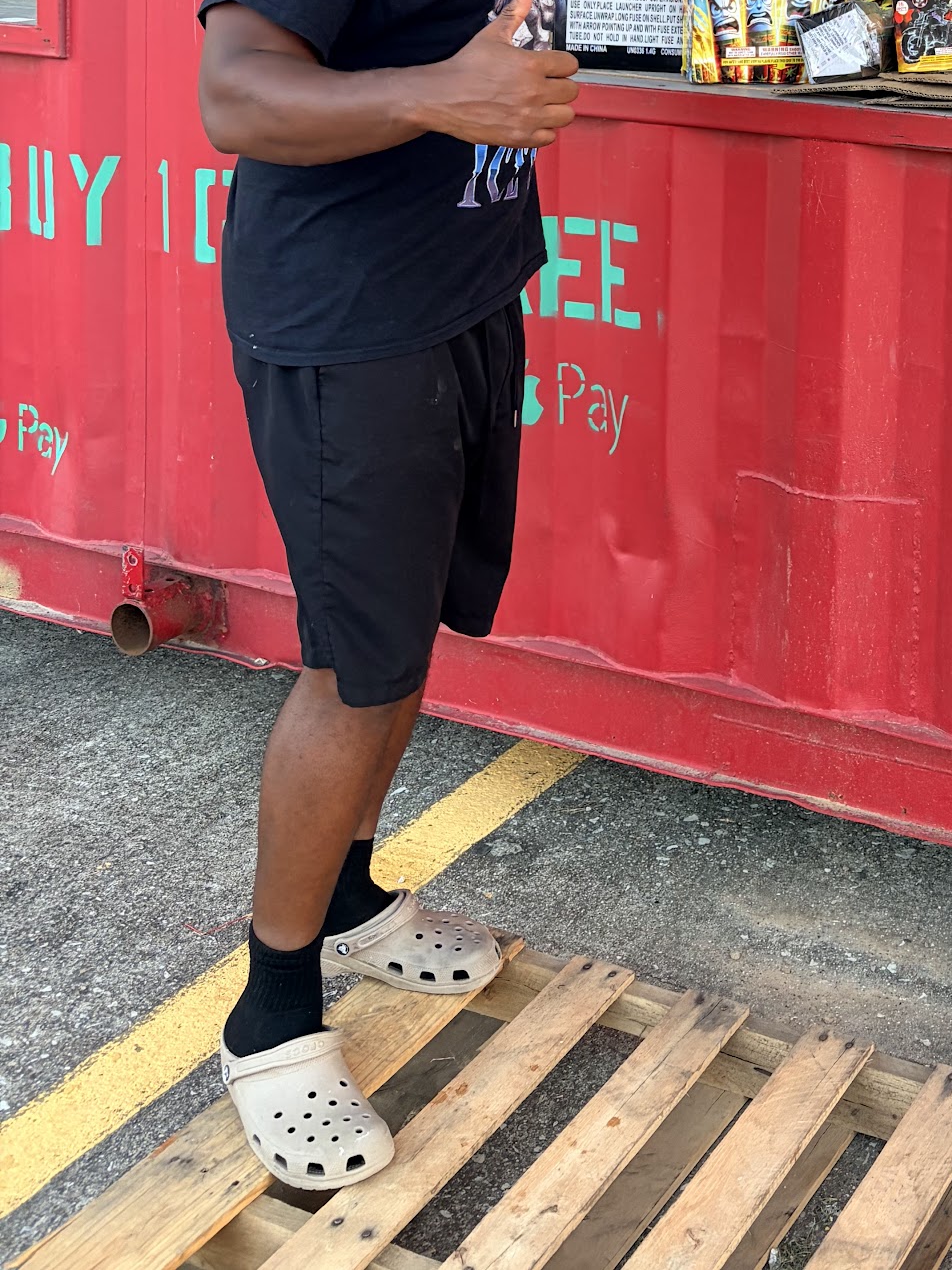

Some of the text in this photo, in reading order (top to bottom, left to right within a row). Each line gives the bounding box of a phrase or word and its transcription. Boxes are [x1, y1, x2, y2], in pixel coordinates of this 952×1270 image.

[571, 0, 580, 8] USE
[616, 3, 642, 11] LAUNCHER
[645, 4, 666, 13] UPRIGHT
[669, 5, 677, 13] ON
[615, 13, 628, 21] LONG
[629, 13, 641, 22] FUSE
[642, 14, 650, 22] ON
[570, 21, 684, 34] WITH ARROW POINTING UP AND WITH FUSE EXTE
[593, 33, 603, 41] NOT
[606, 33, 619, 42] HOLD
[622, 34, 628, 42] IN
[661, 36, 674, 44] FUSE
[566, 44, 582, 52] MADE
[590, 45, 608, 53] CHINA
[660, 48, 683, 56] CONSUM
[521, 216, 641, 329] EE
[557, 363, 629, 455] Pay
[18, 403, 69, 476] Pay
